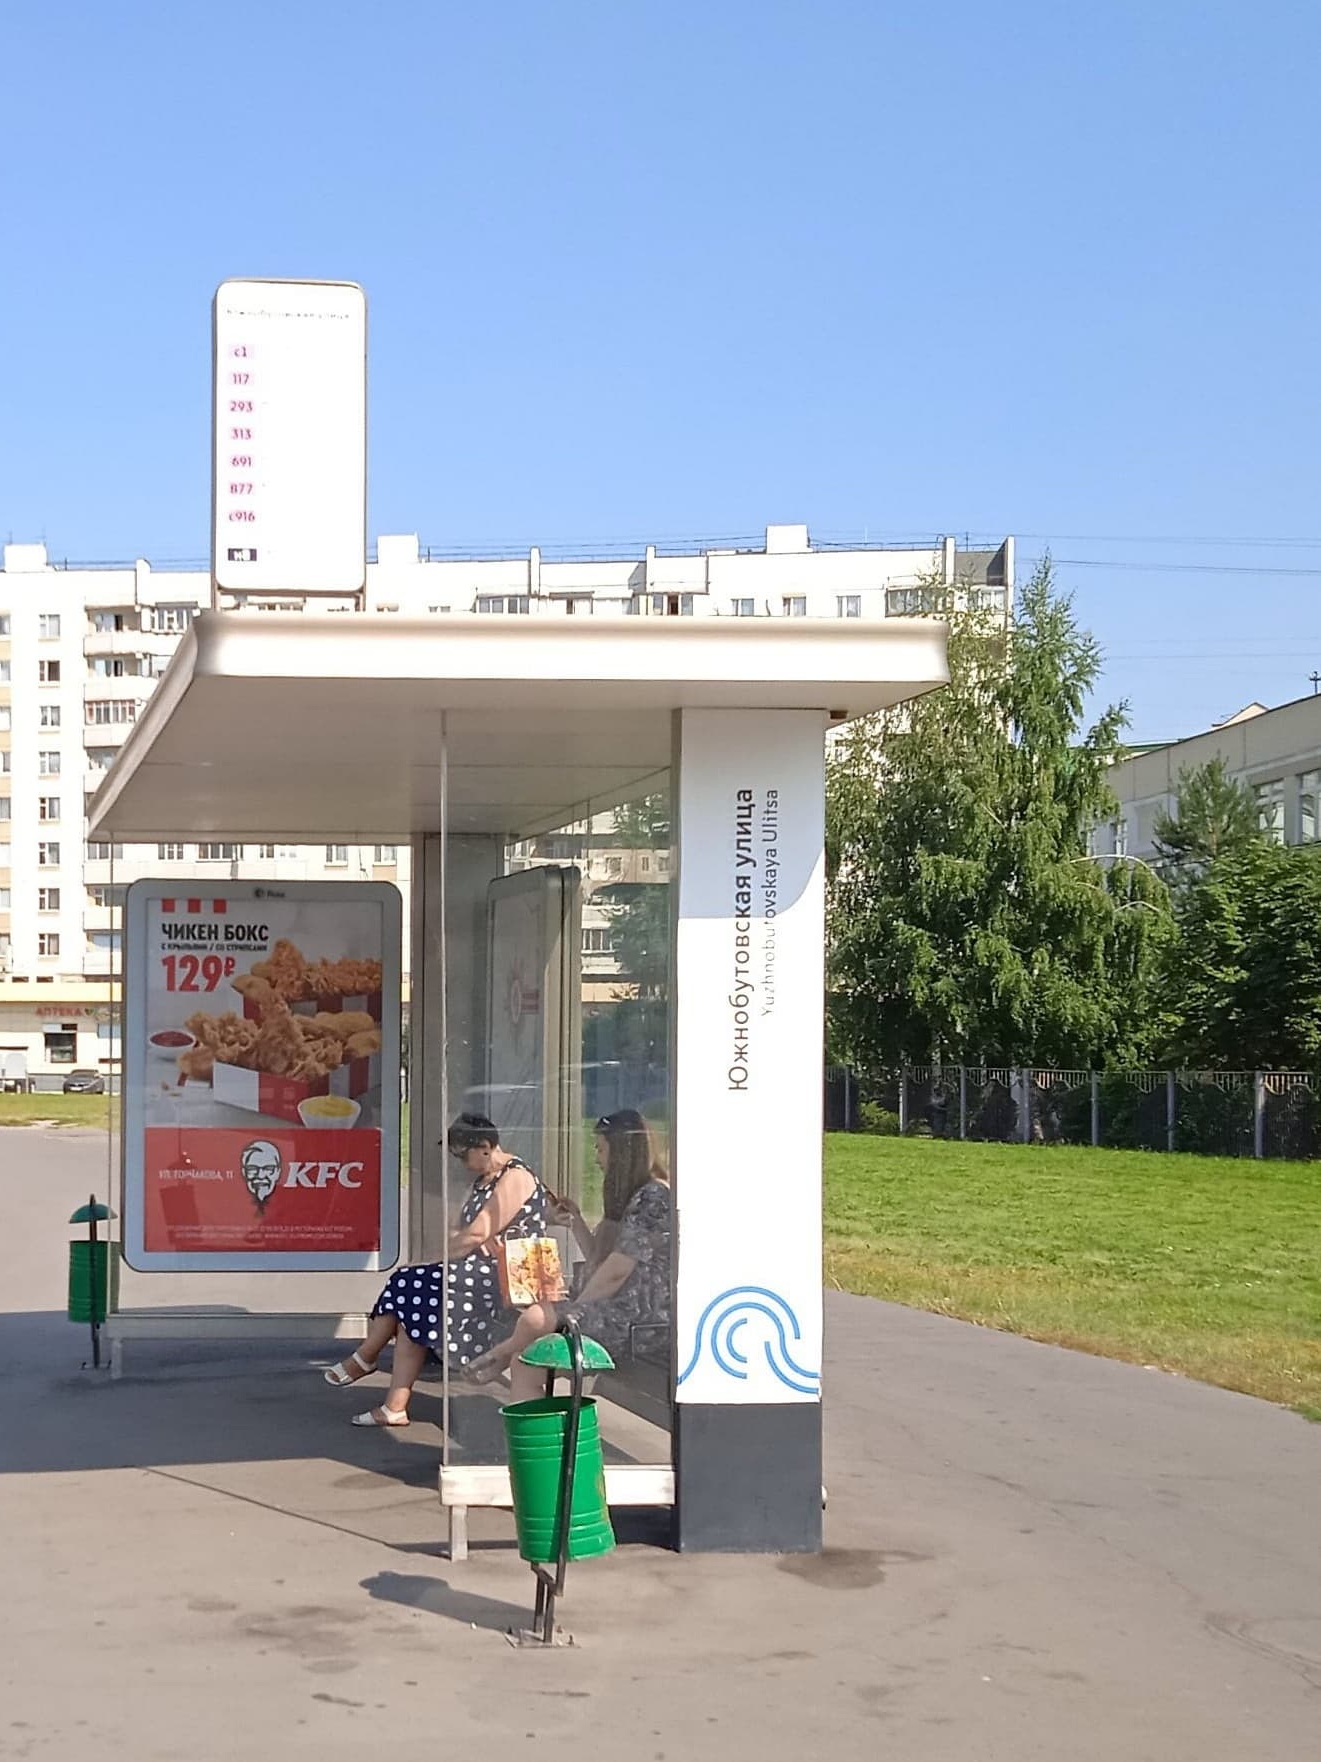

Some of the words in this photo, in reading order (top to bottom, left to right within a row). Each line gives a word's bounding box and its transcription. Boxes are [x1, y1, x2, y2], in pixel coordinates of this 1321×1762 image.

[233, 373, 250, 385] 117
[230, 400, 253, 413] 293
[231, 427, 252, 440] 313
[231, 456, 252, 468] 691
[230, 482, 253, 495] 877
[761, 789, 778, 842] Ulitsa
[736, 789, 757, 868] улица
[161, 923, 218, 940] ЧИКЕН
[224, 924, 269, 941] БОКС
[761, 848, 780, 1017] Yuzhnobutovskaya
[728, 875, 755, 1091] Южнобутовская
[283, 1162, 364, 1188] KFC
